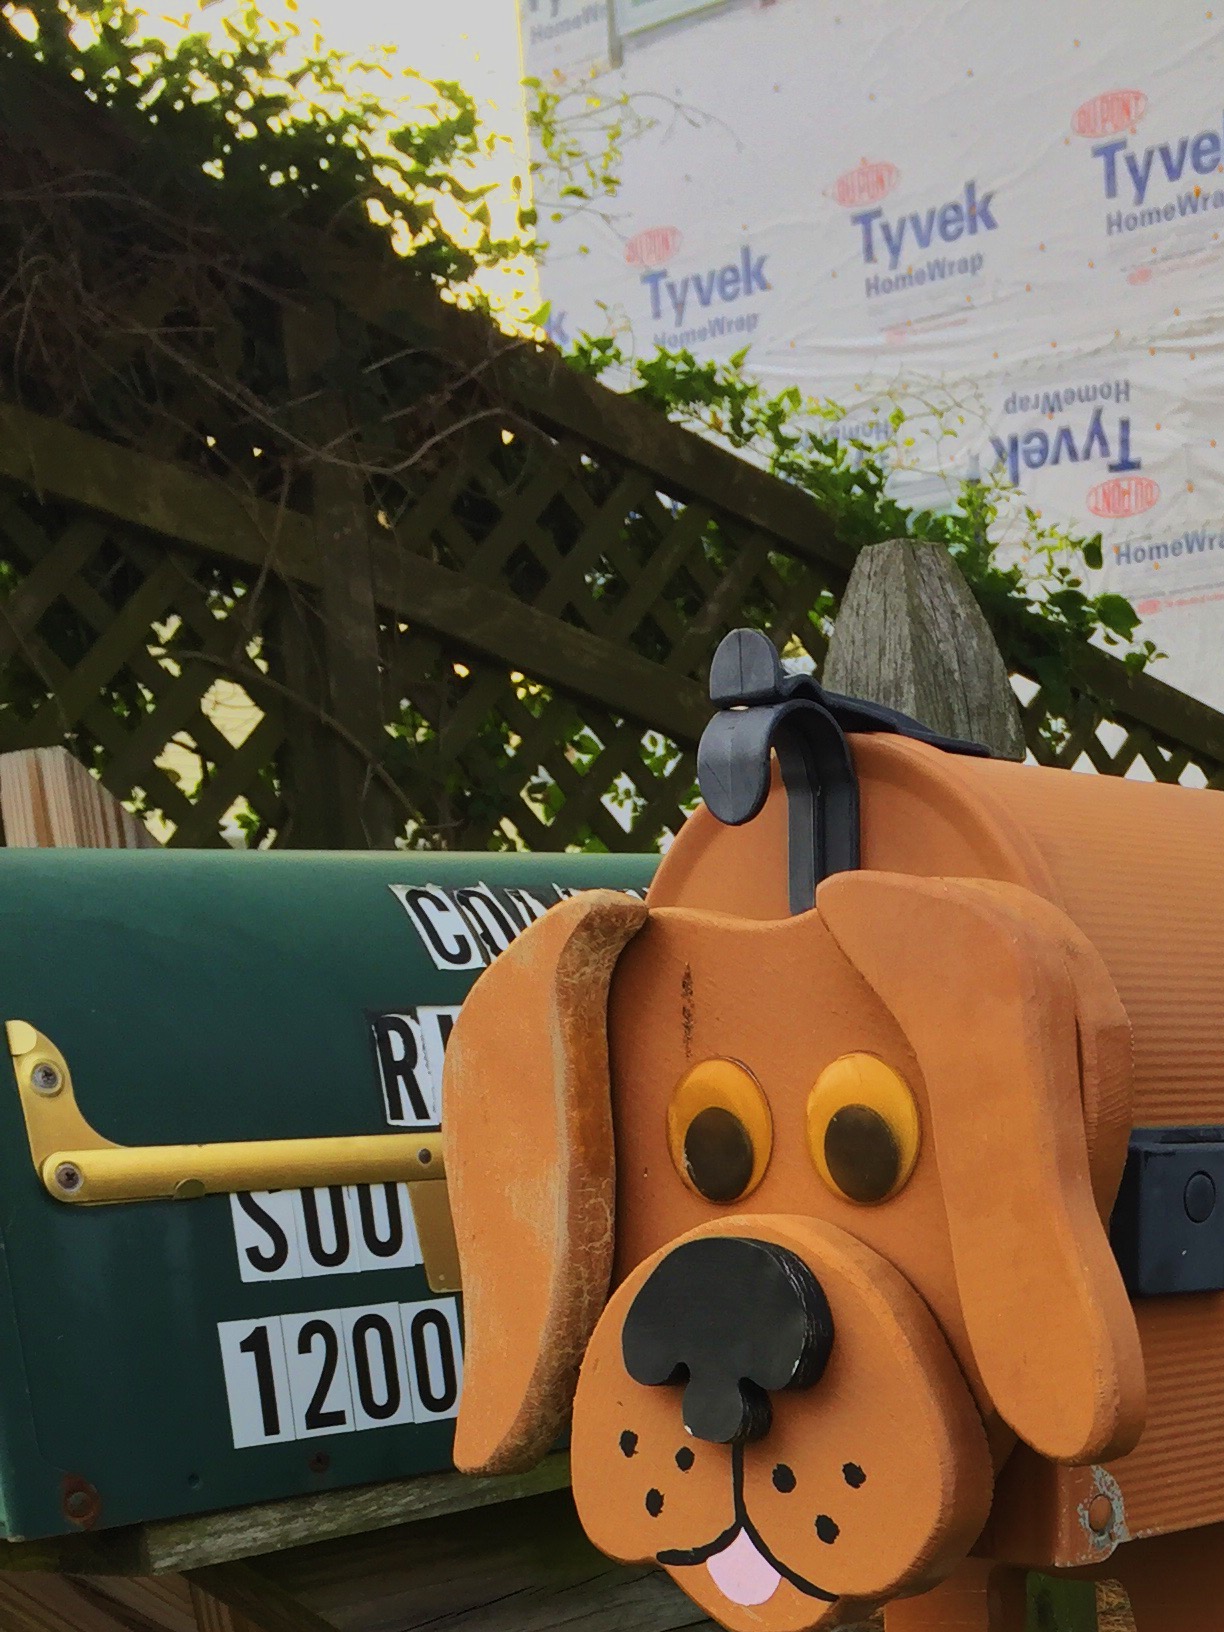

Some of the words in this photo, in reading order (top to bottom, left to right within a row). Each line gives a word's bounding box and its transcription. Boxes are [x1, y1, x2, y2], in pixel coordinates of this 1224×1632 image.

[851, 179, 999, 270] Tyvek
[640, 244, 771, 338] Tyvek
[864, 252, 984, 298] HomeWrap
[653, 312, 760, 350] HomeWrap
[1003, 379, 1130, 416] HomeWrap
[989, 406, 1142, 488] Tyvek
[239, 1307, 459, 1437] 1200
